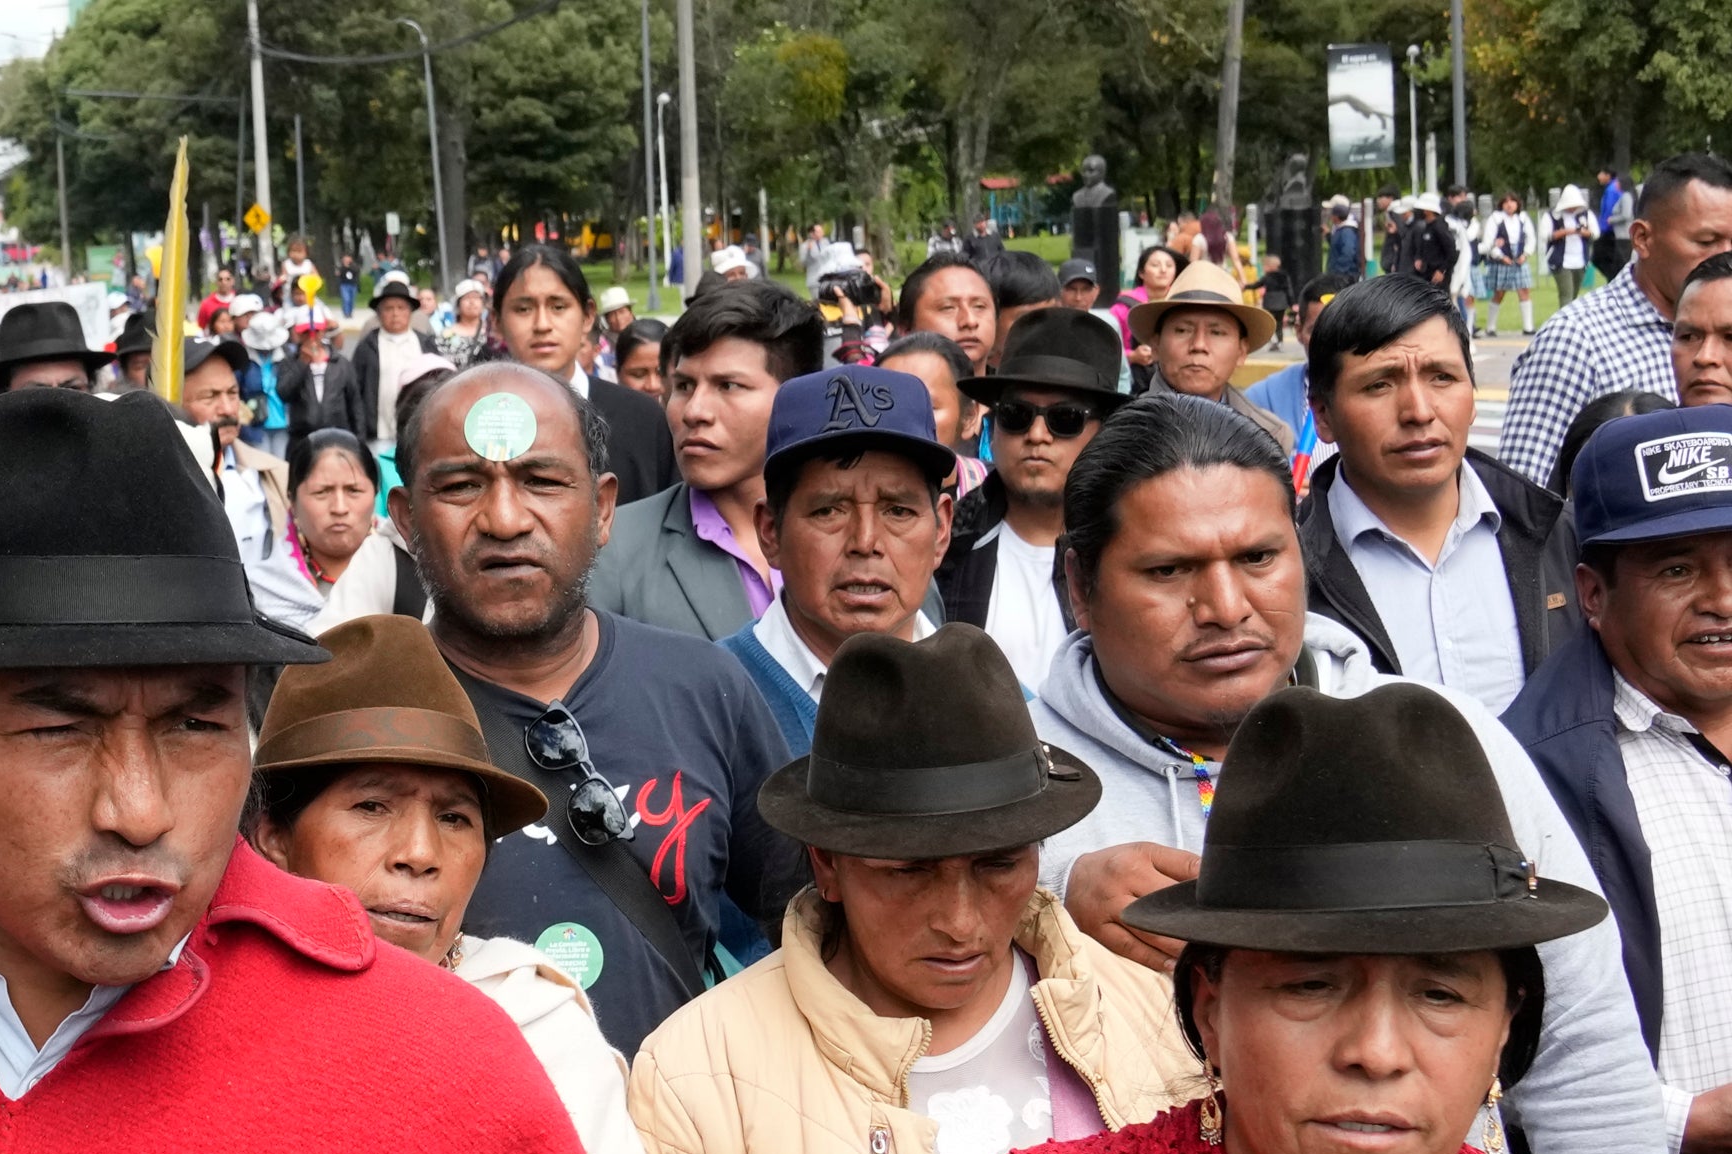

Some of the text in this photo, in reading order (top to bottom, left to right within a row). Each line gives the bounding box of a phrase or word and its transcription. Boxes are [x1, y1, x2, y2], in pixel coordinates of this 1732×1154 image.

[819, 374, 895, 434] A's
[1642, 437, 1730, 457] NIKE SKATEBOARDING
[1667, 445, 1713, 470] NIKE
[1706, 465, 1730, 479] SB
[1650, 482, 1699, 496] PROPRIETARY
